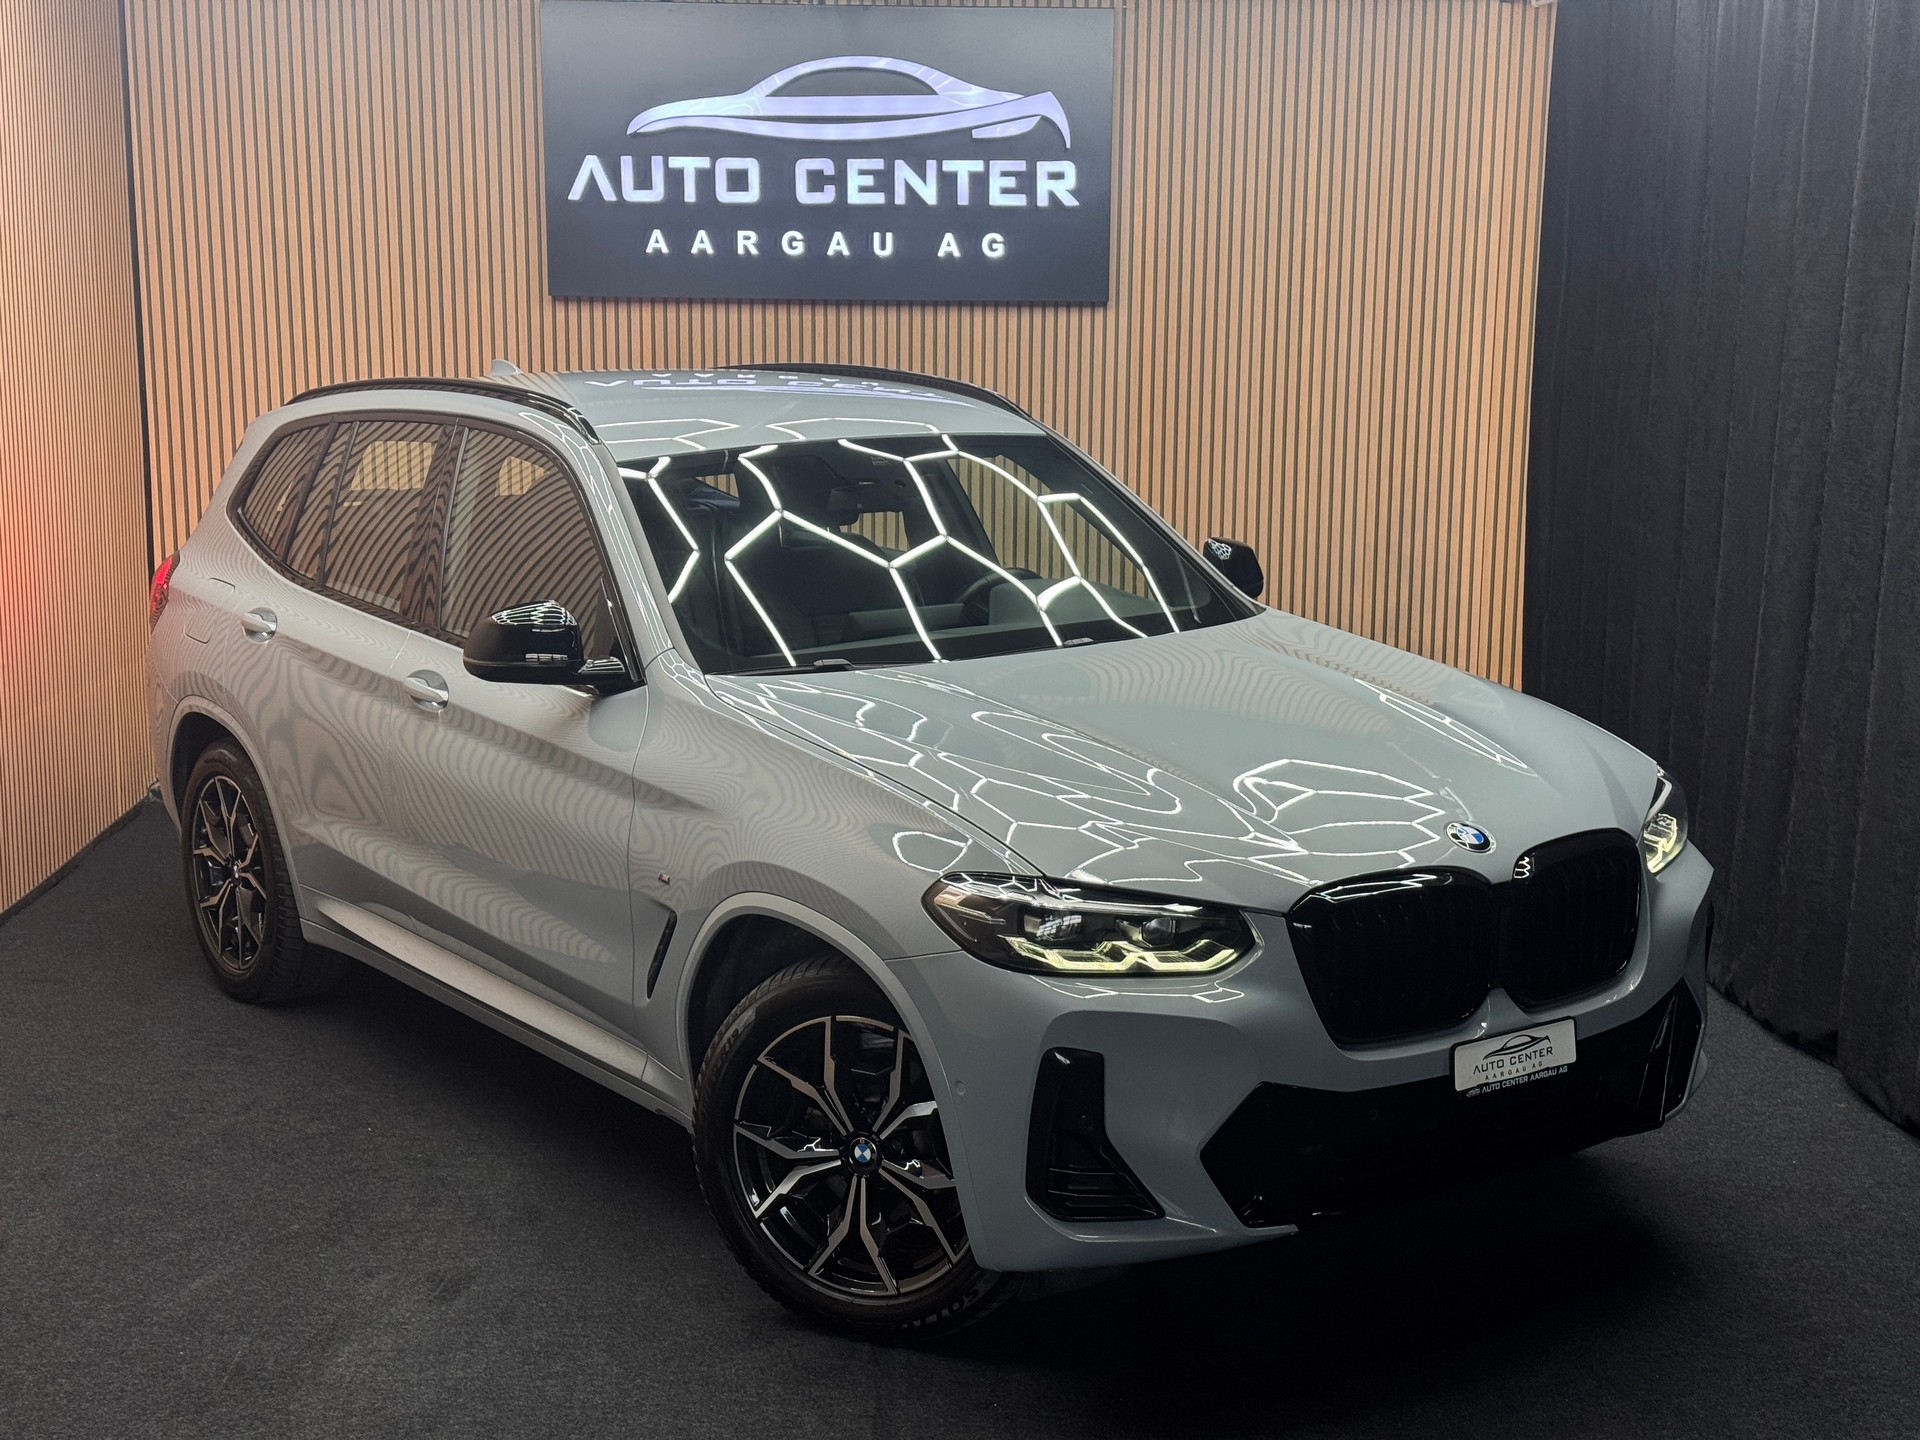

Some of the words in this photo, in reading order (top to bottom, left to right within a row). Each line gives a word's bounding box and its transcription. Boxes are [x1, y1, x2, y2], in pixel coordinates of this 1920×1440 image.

[567, 154, 761, 205] AUTO
[795, 157, 1080, 207] CENTER
[645, 229, 894, 257] AARGAU
[937, 232, 1007, 258] AG
[1473, 1059, 1505, 1075] AUTO
[1509, 1046, 1554, 1066] CENTER
[1484, 1066, 1527, 1081] AARGAU
[1532, 1061, 1543, 1070] AG
[1482, 1082, 1501, 1094] AUTO
[1502, 1075, 1529, 1089] CENTER
[1530, 1070, 1558, 1081] AARGAU
[1558, 1065, 1568, 1074] AG
